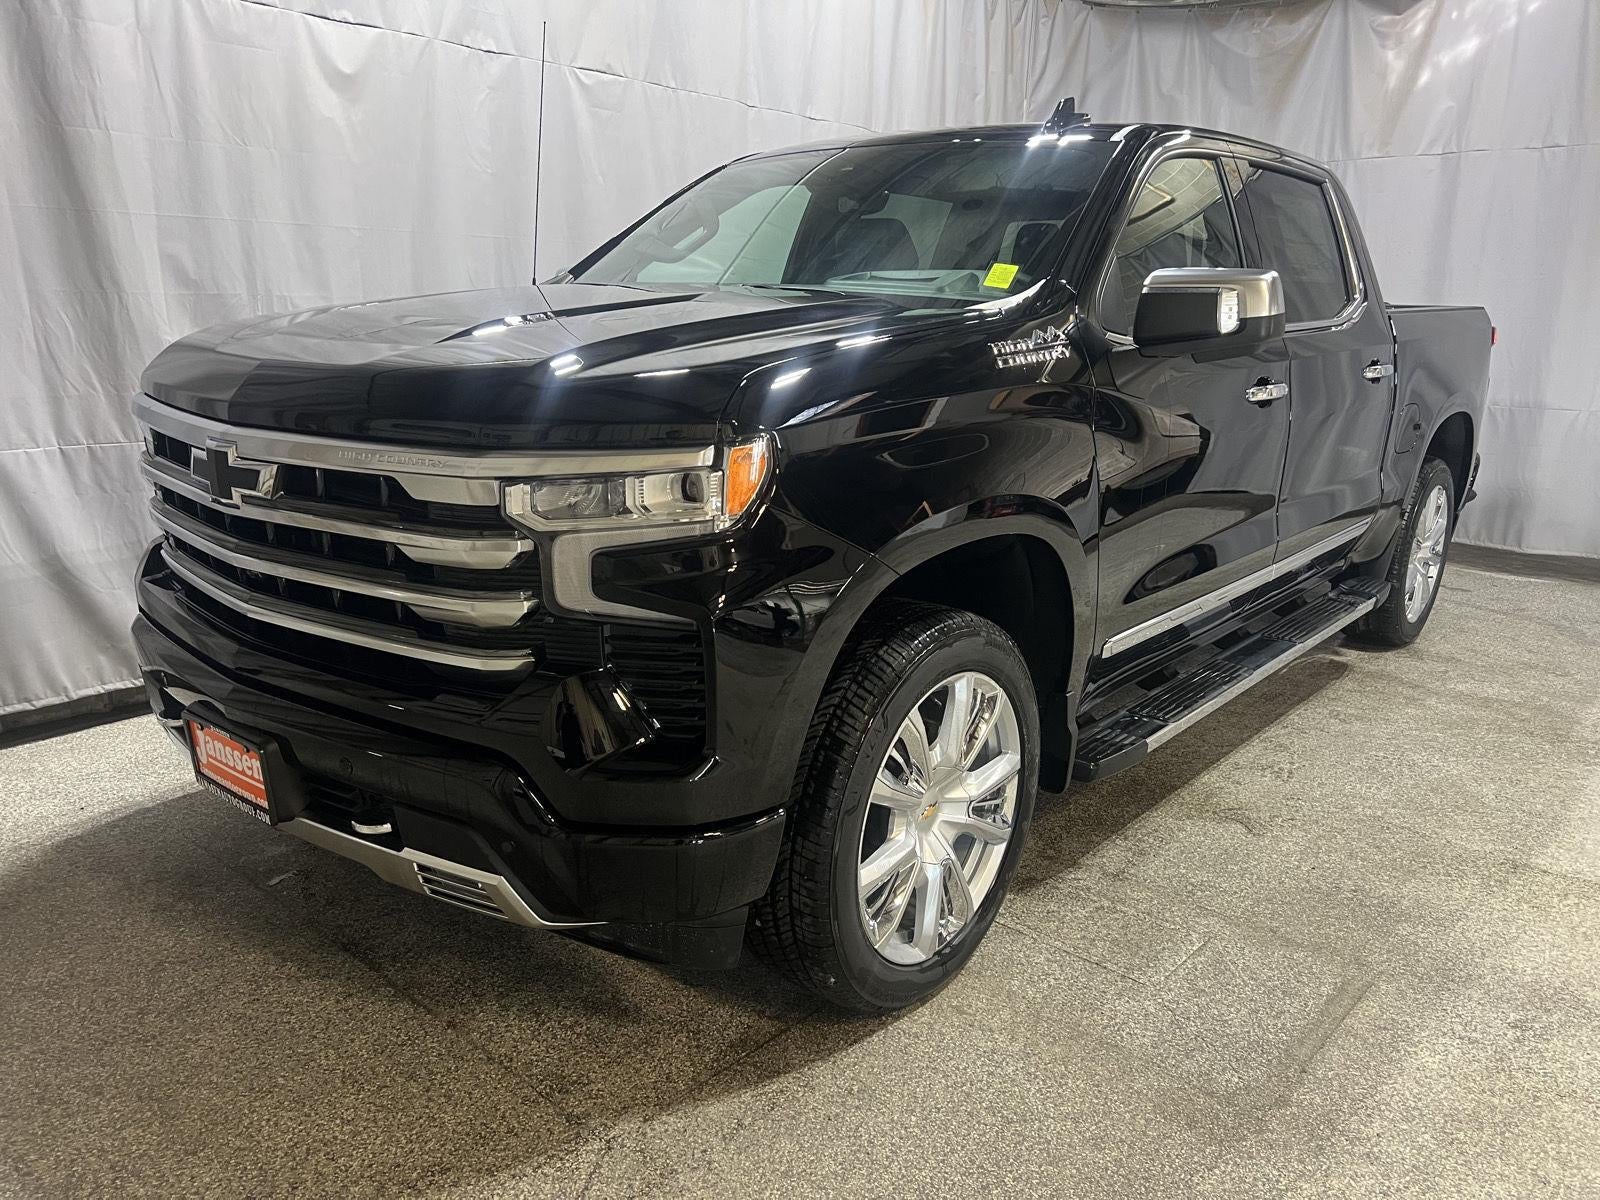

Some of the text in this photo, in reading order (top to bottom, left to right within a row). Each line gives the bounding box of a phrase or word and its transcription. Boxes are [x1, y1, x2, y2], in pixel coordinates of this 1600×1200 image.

[987, 338, 1035, 355] HIGH
[996, 346, 1072, 368] COUNTRY
[376, 454, 446, 468] COUNTRY
